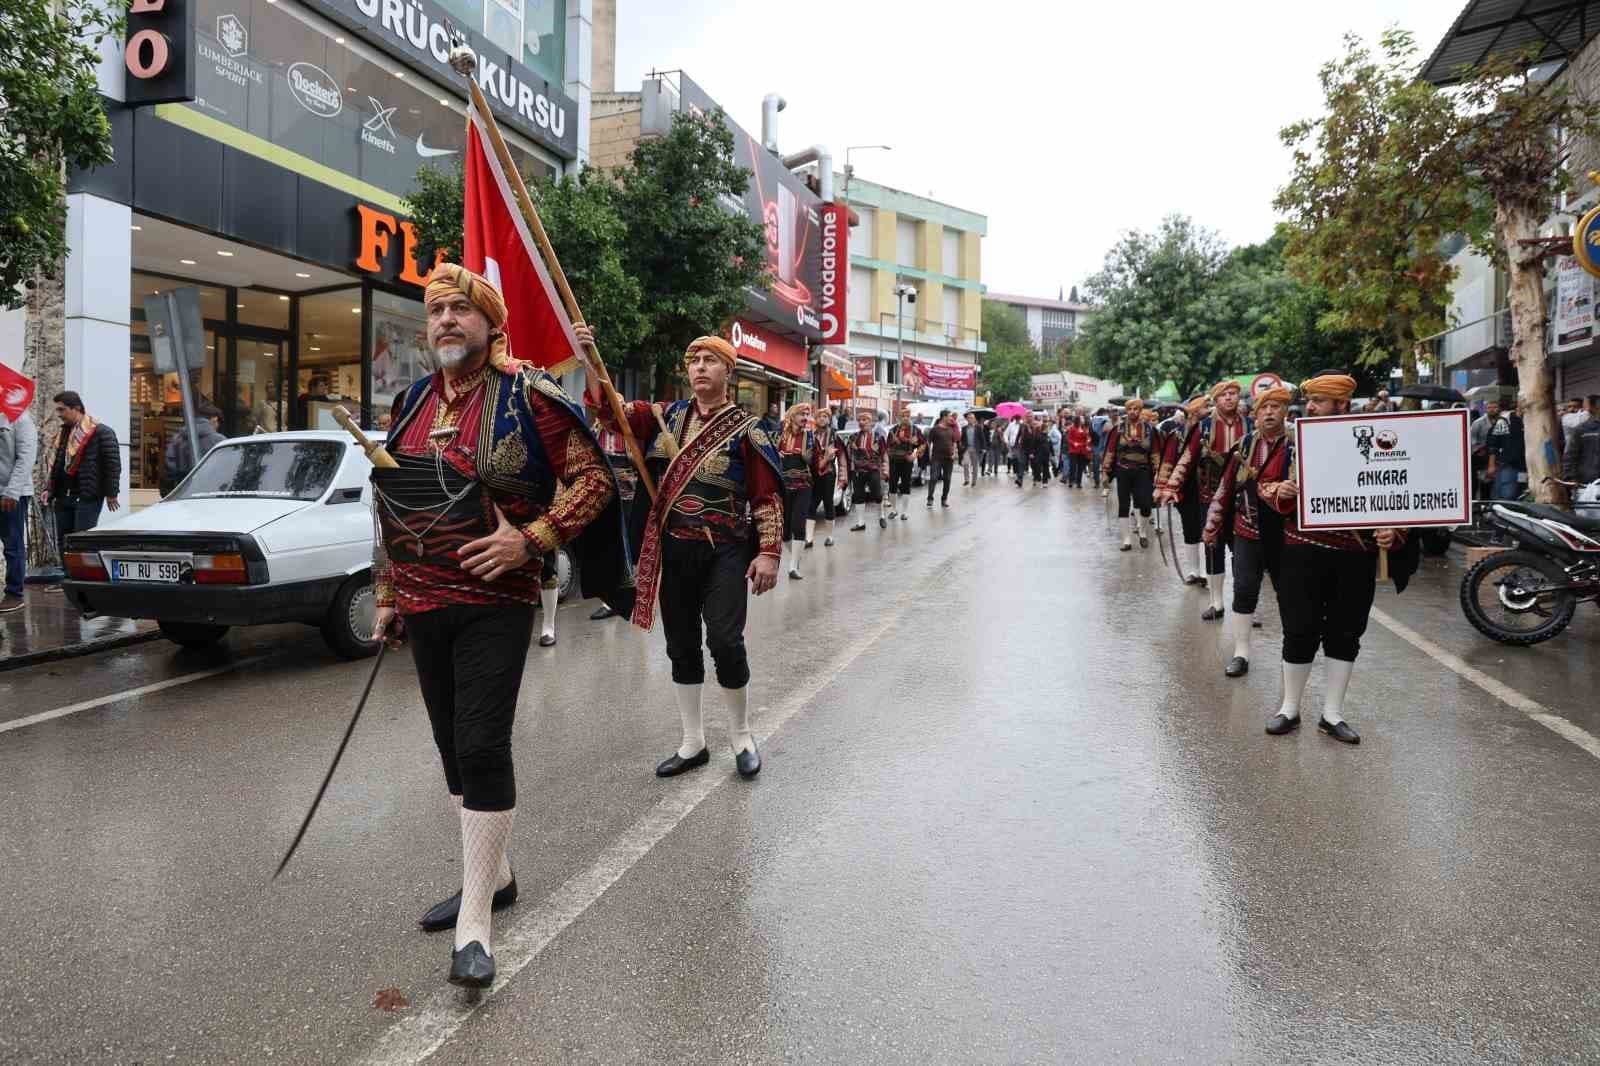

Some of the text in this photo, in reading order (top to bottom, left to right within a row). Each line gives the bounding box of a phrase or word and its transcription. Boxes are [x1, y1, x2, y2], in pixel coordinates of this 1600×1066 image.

[479, 54, 565, 138] KURSU
[361, 128, 397, 154] kinetix
[822, 211, 837, 309] vodafone
[1373, 450, 1408, 458] ANKARA
[1357, 469, 1408, 487] ANKARA
[1310, 488, 1458, 515] SEYMENLER KULÜBÜ DERNEĞİ
[119, 563, 178, 580] 01 RU 598
